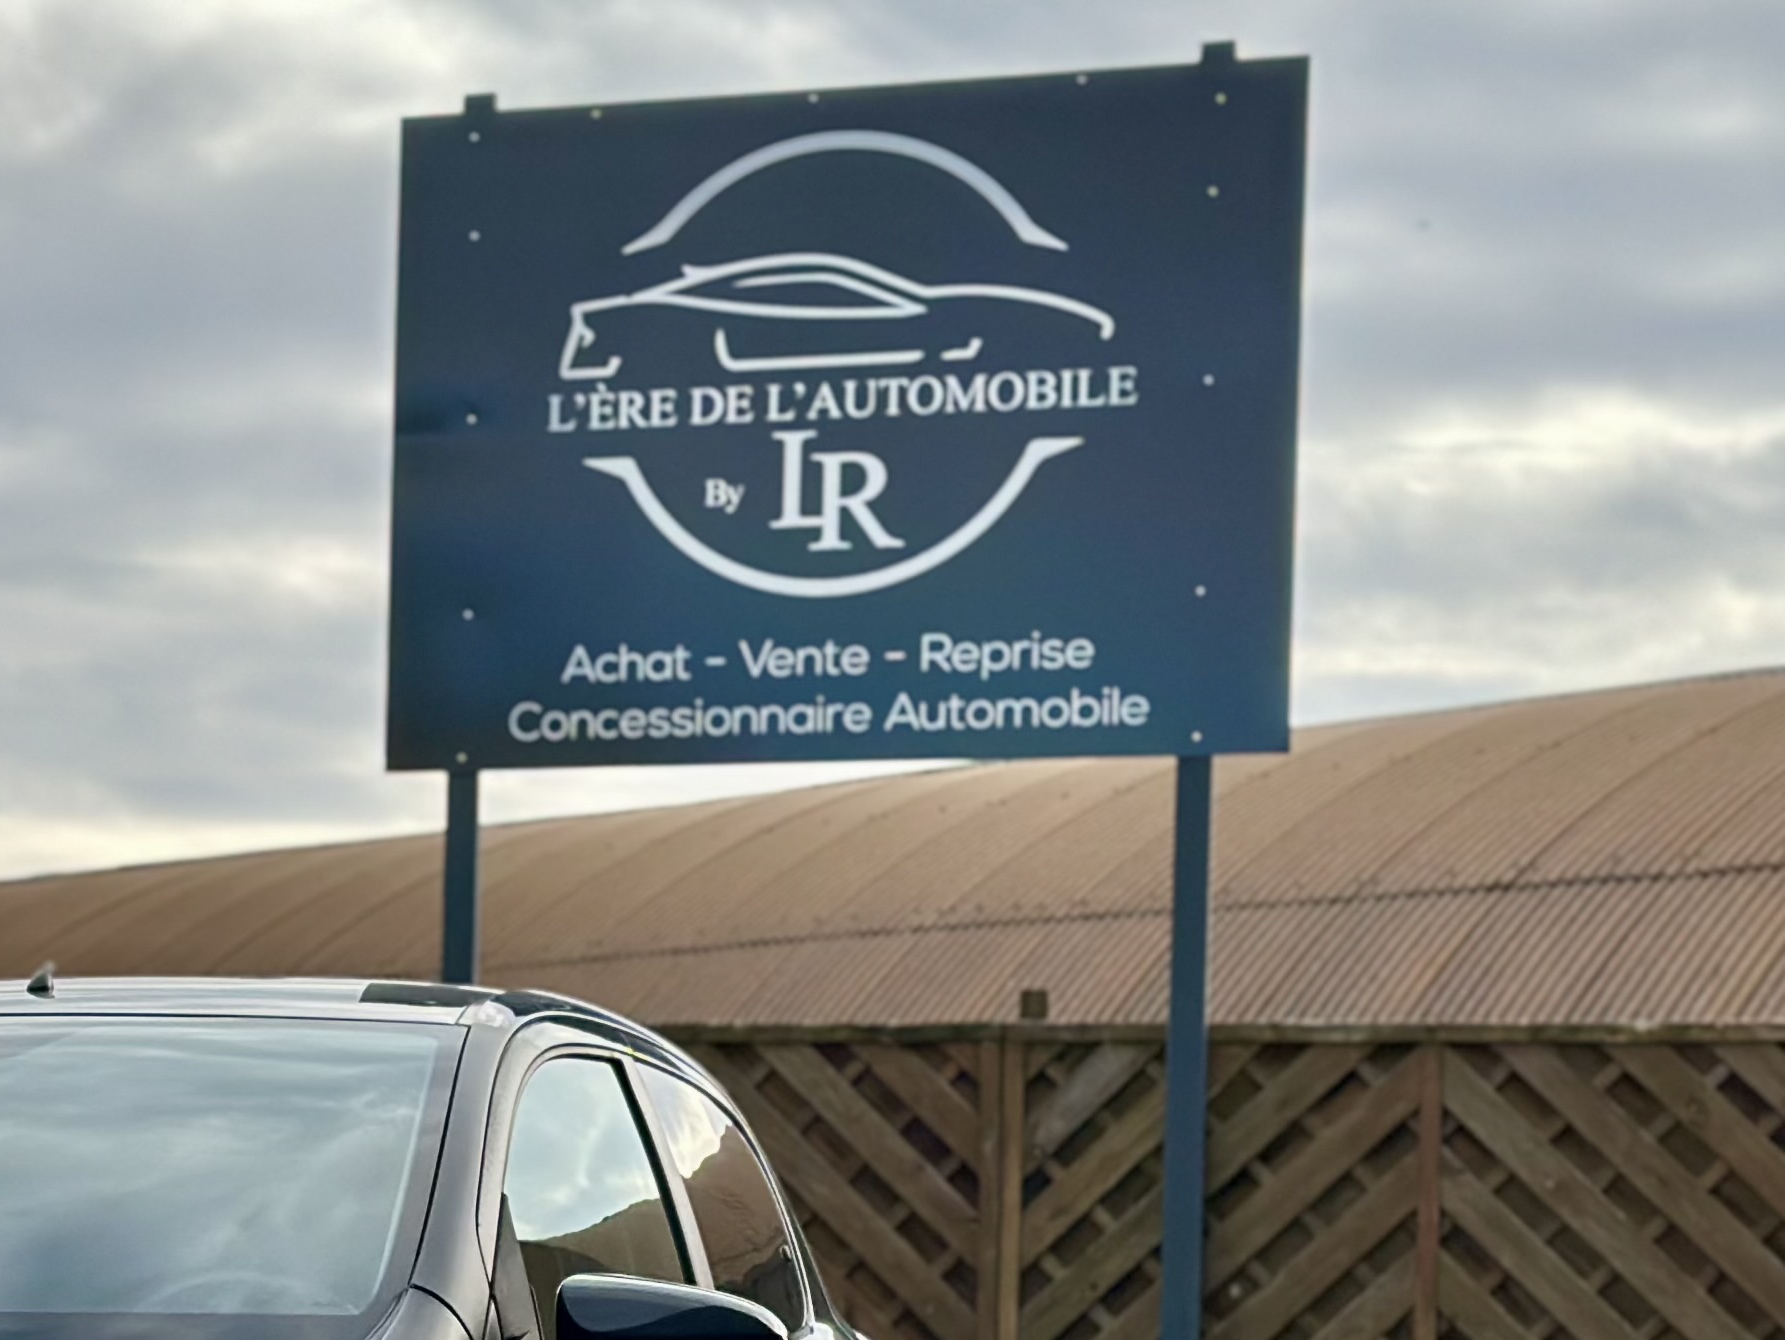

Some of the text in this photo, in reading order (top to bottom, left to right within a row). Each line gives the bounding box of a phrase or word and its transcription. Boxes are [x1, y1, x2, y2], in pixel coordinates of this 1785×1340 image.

[547, 366, 1139, 433] L'ÈRE DE L'AUTOMOBILE
[703, 477, 746, 515] By
[560, 643, 692, 684] Achat
[738, 637, 871, 679] Vente
[919, 629, 1096, 681] Reprise
[507, 686, 1151, 743] Concessionnaire Automobile
